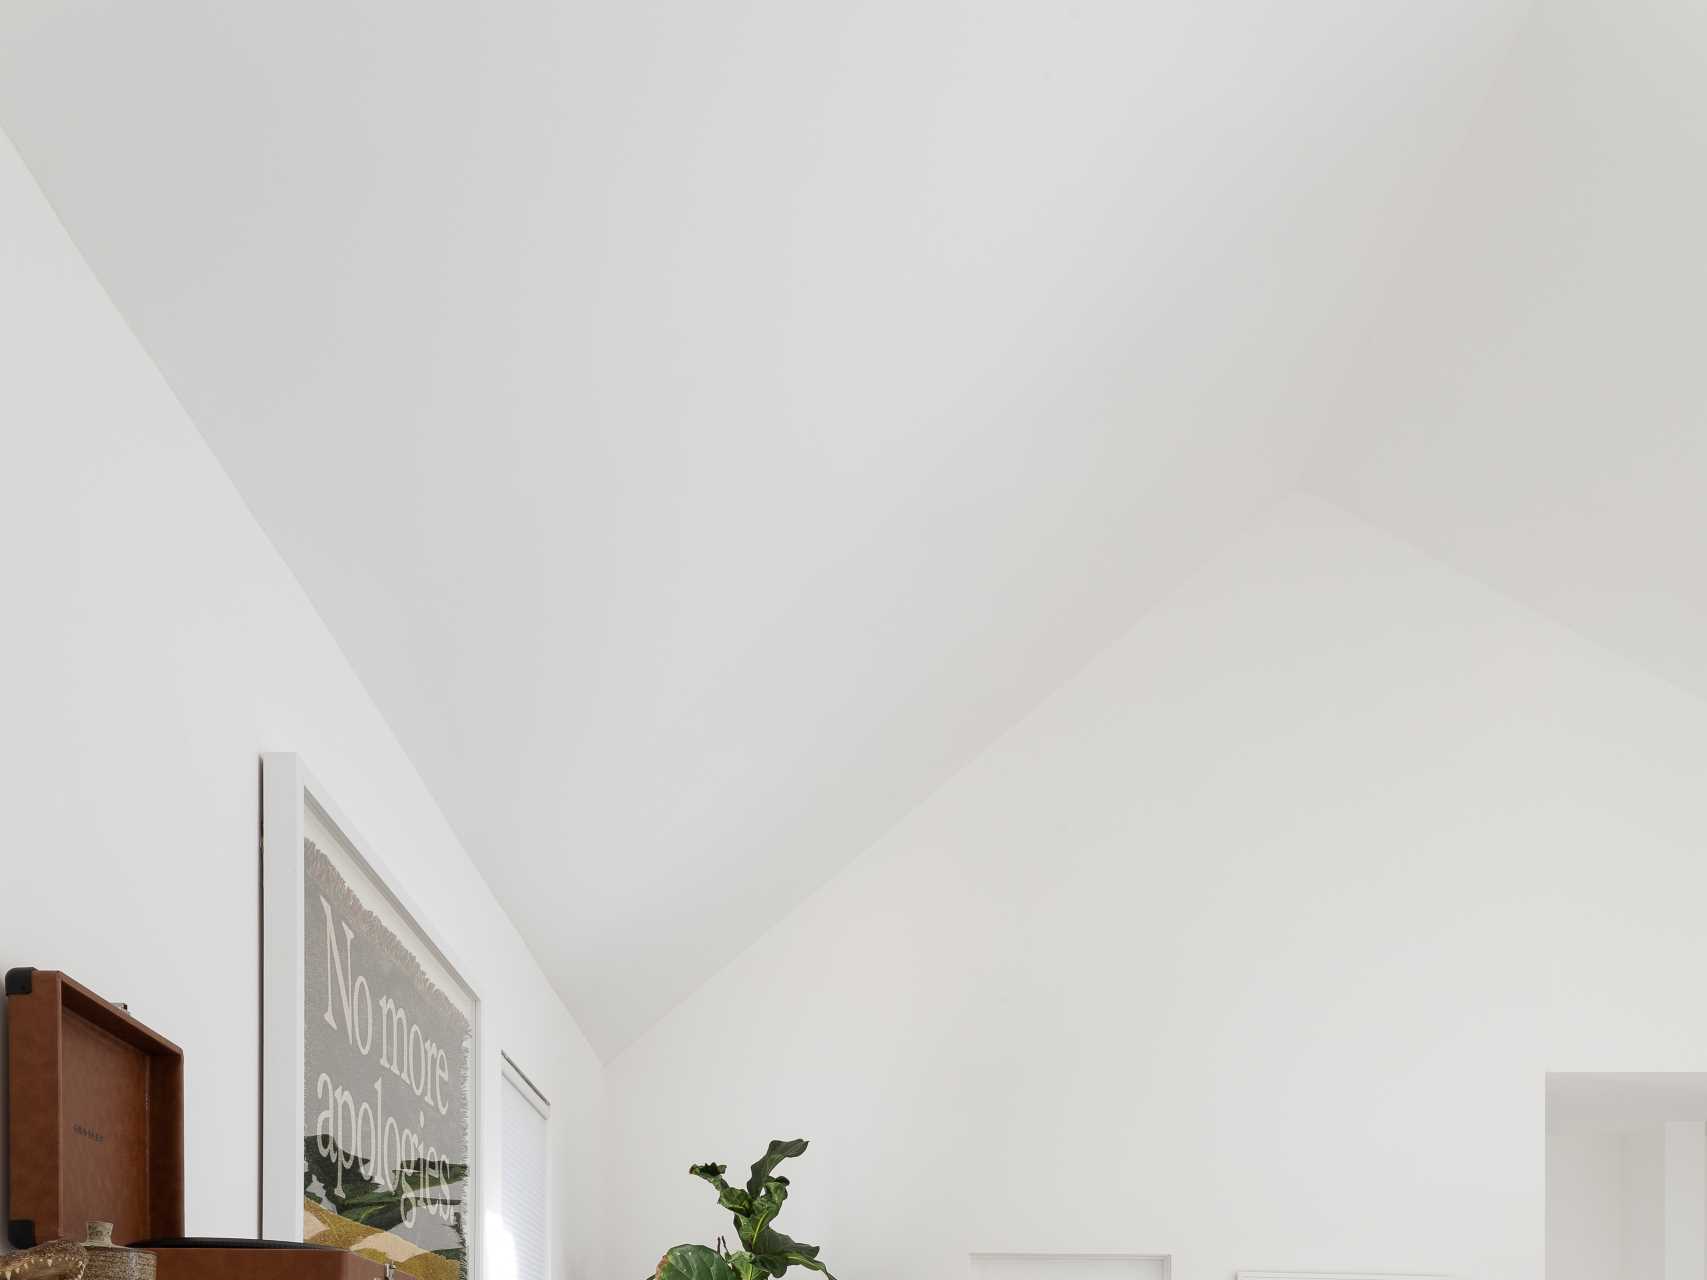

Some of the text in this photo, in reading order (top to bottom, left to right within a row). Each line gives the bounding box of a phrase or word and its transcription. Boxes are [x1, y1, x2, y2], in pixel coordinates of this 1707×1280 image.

[319, 895, 449, 1115] No more
[316, 1072, 456, 1229] apologies.
